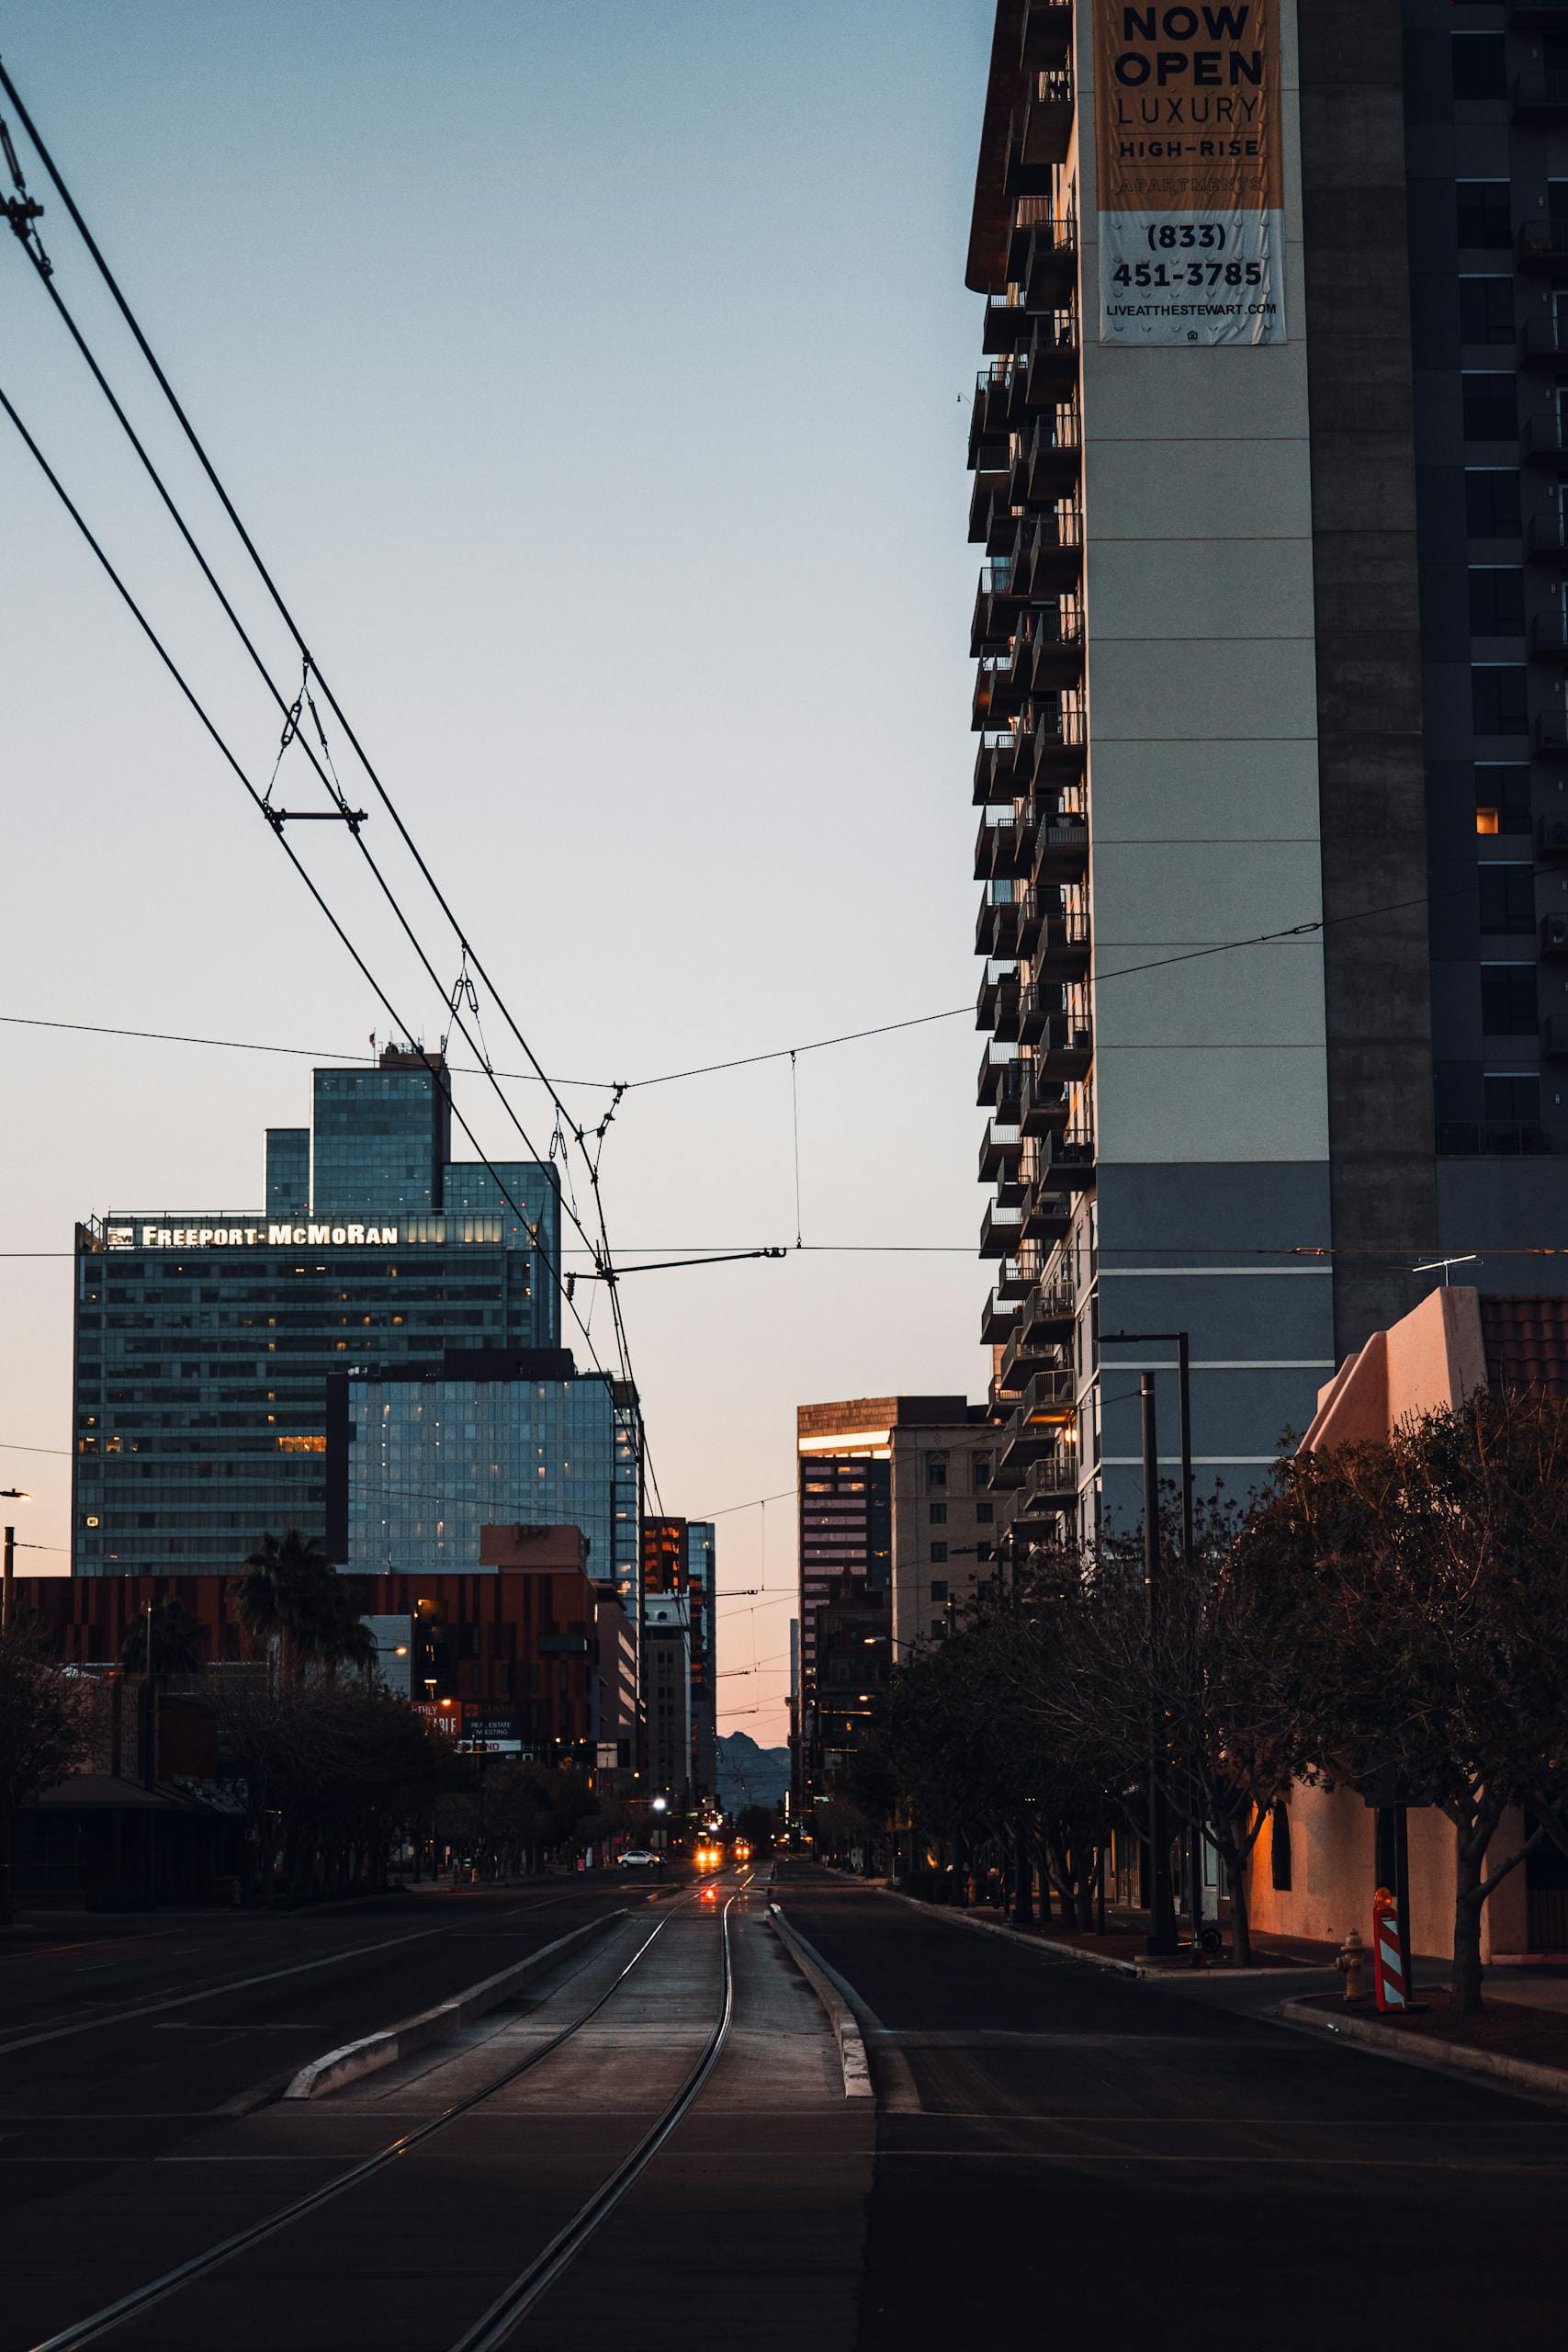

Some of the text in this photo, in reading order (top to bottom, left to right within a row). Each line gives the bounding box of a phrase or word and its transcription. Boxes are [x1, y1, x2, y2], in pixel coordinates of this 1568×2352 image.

[1123, 6, 1248, 41] NOW
[1114, 51, 1262, 86] OPEN
[1118, 96, 1259, 124] LUXURY
[1120, 140, 1258, 157] HIGH-RISE
[1120, 176, 1263, 193] APARTMENTS
[1147, 223, 1225, 250] (833)
[1113, 262, 1262, 287] 451-3785
[1107, 303, 1277, 316] LIVEATTHESTEWART.COM
